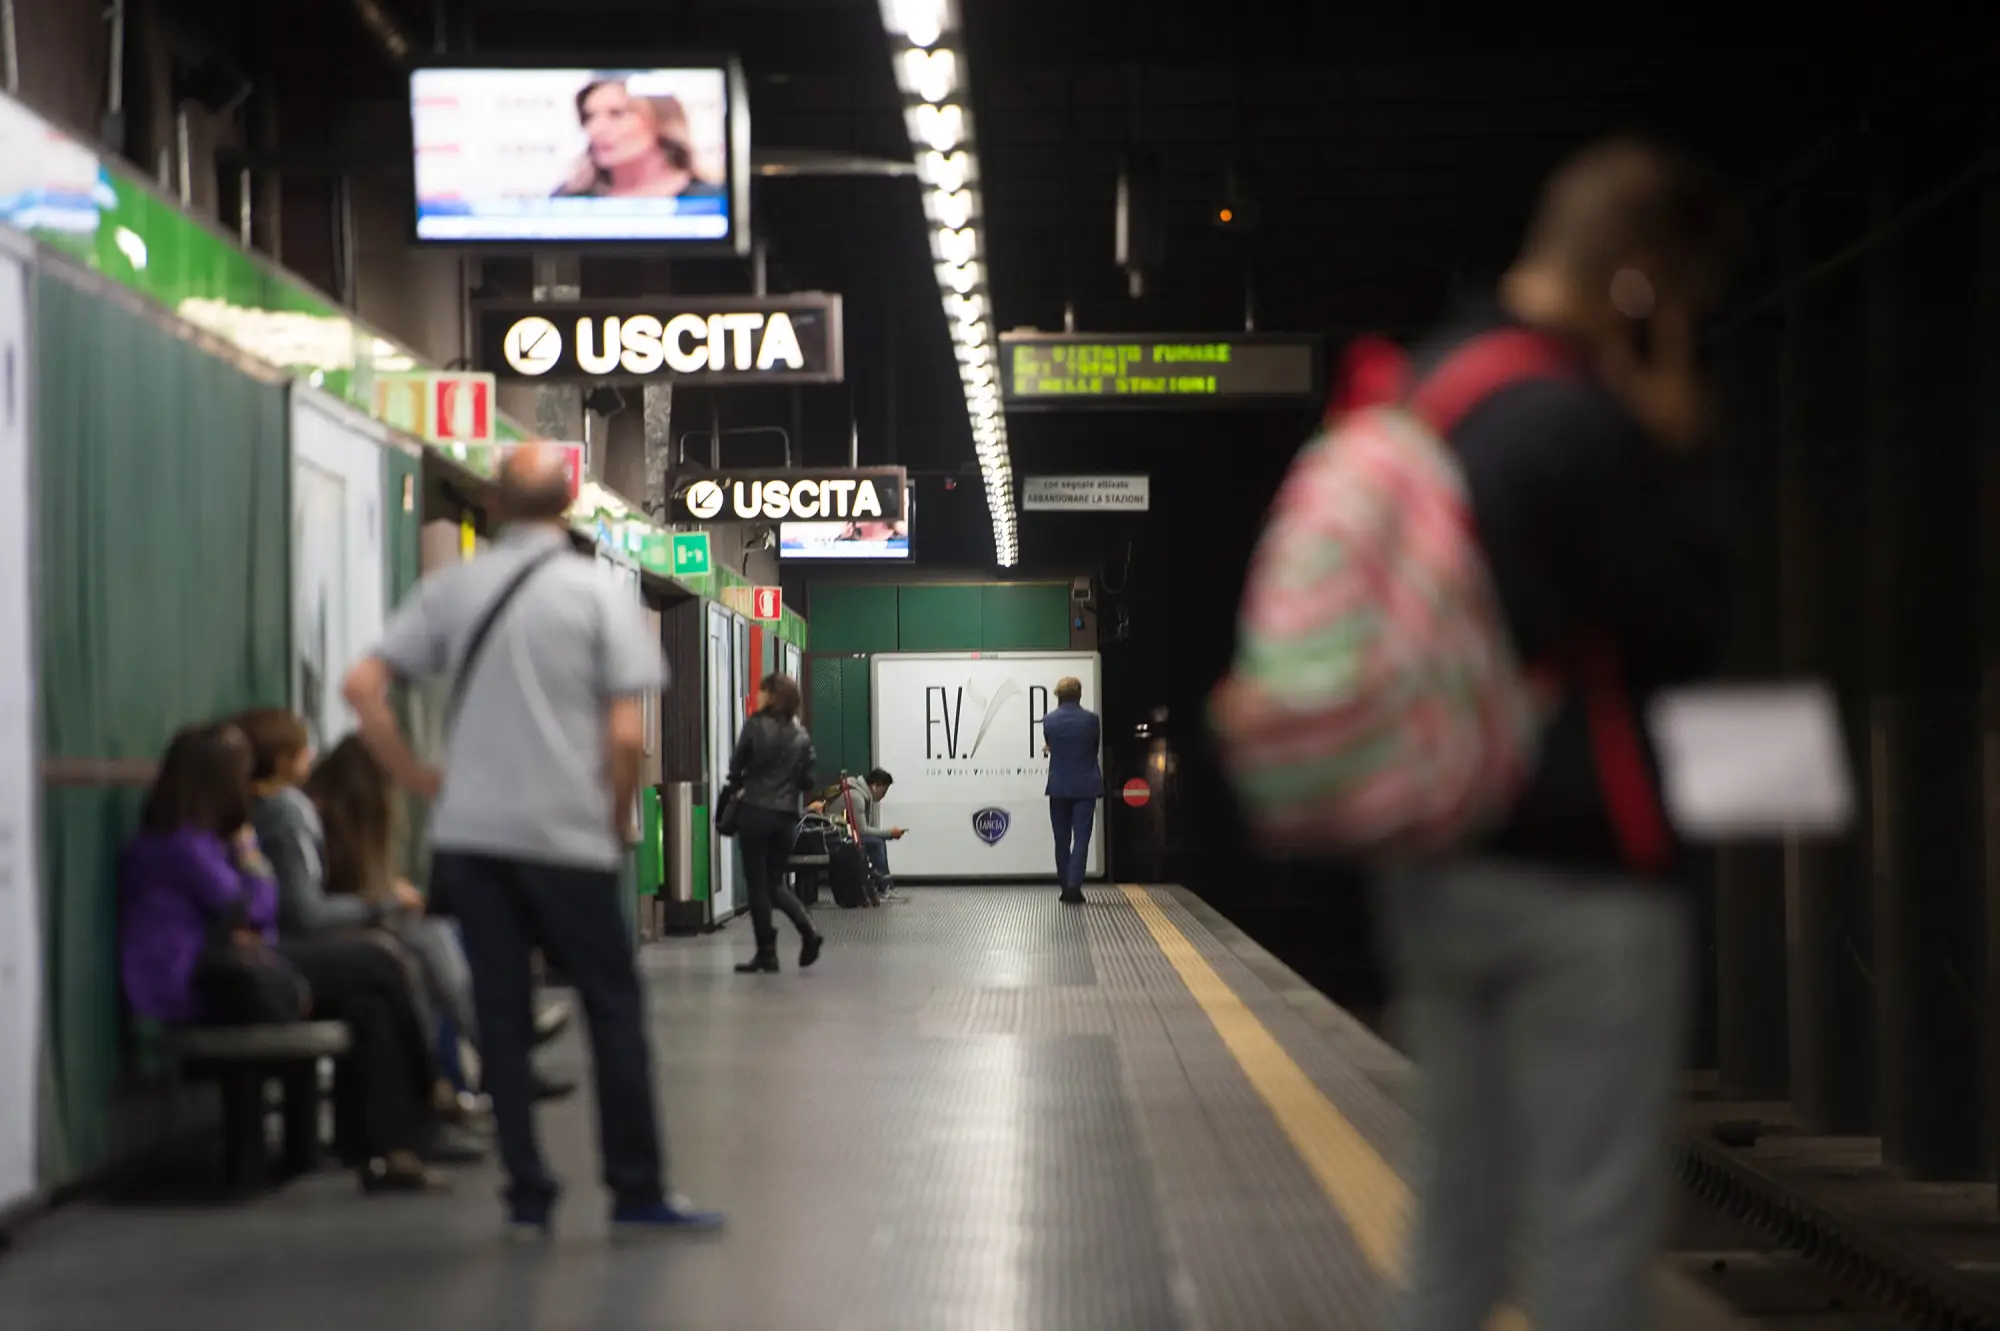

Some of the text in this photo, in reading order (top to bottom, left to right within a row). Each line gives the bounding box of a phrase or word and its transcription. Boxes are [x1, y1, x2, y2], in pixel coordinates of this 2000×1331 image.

[576, 312, 804, 375] USCITA
[733, 480, 882, 519] USCITA
[1027, 494, 1089, 504] ABBANDONARE
[1092, 494, 1103, 504] LA
